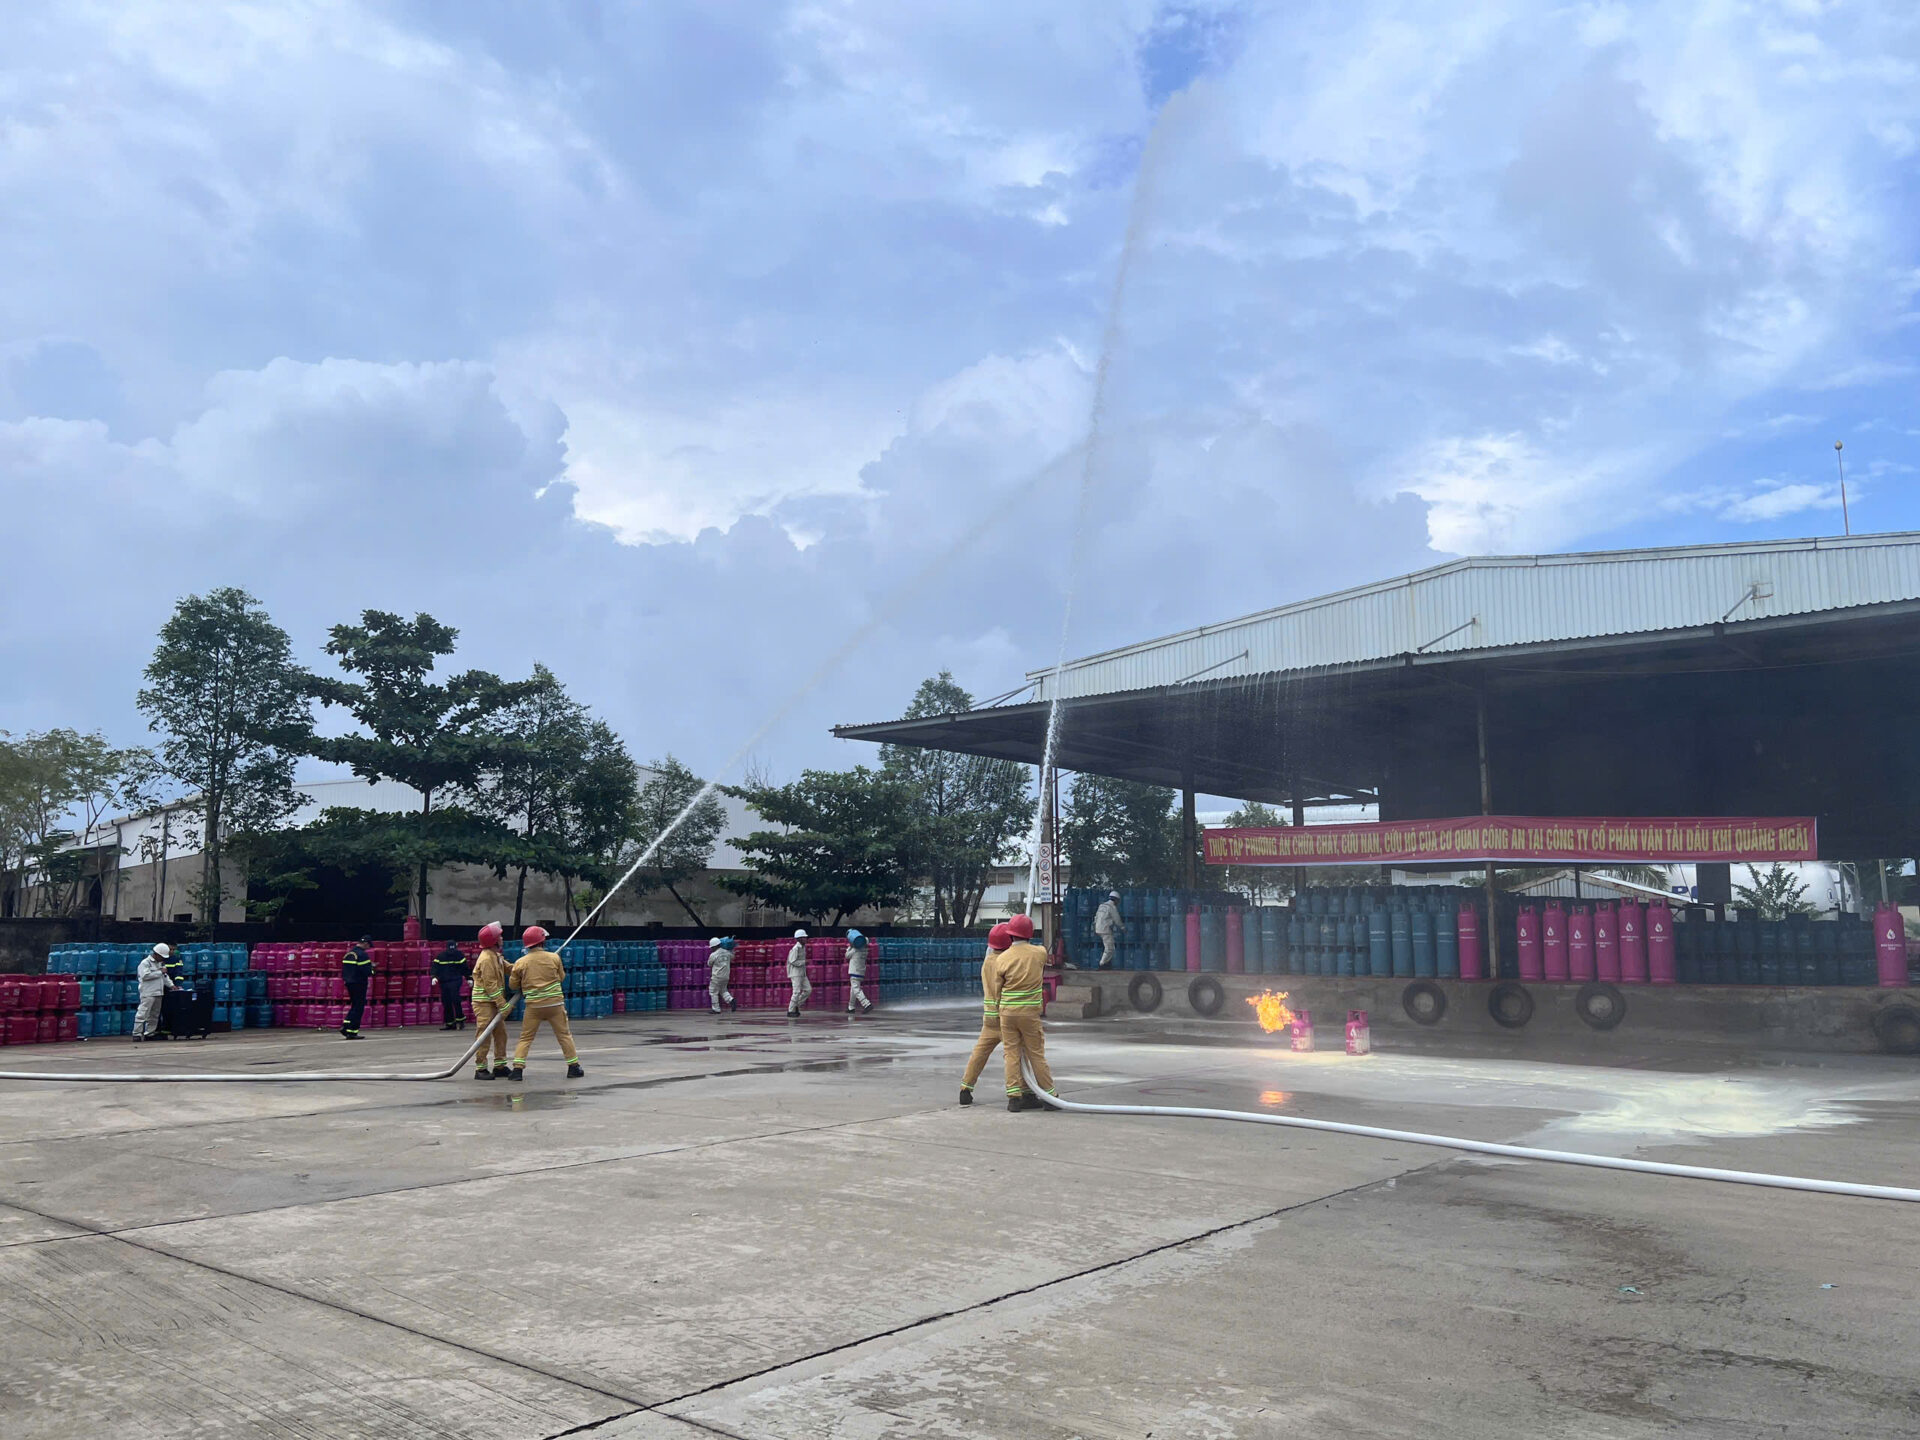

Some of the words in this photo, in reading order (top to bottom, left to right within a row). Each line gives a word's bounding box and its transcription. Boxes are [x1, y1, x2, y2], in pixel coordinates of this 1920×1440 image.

[1208, 836, 1227, 860] THỰC
[1229, 834, 1243, 860] TẬP
[1245, 836, 1277, 856] PHƯƠNG
[1279, 833, 1291, 856] ÁN
[1293, 832, 1314, 856] CHỮA
[1317, 831, 1340, 856] CHÁY,
[1341, 829, 1358, 853] CỨU
[1384, 828, 1402, 853] CỨU
[1404, 827, 1417, 857] HỘ
[1419, 824, 1437, 852] CỦA
[1440, 830, 1452, 850] CƠ
[1455, 829, 1480, 852] QUAN
[1482, 824, 1509, 849] CÔNG
[1511, 828, 1525, 850] AN
[1528, 828, 1543, 855] TẠI
[1547, 824, 1574, 850] CÔNG
[1577, 829, 1588, 850] TY
[1592, 821, 1607, 850] CỔ
[1641, 824, 1663, 856] VẬN
[1666, 822, 1683, 851] TẢI
[1712, 824, 1732, 851] KHÍ
[1735, 822, 1776, 854] QUẢNG
[1779, 823, 1808, 851] NGÃI
